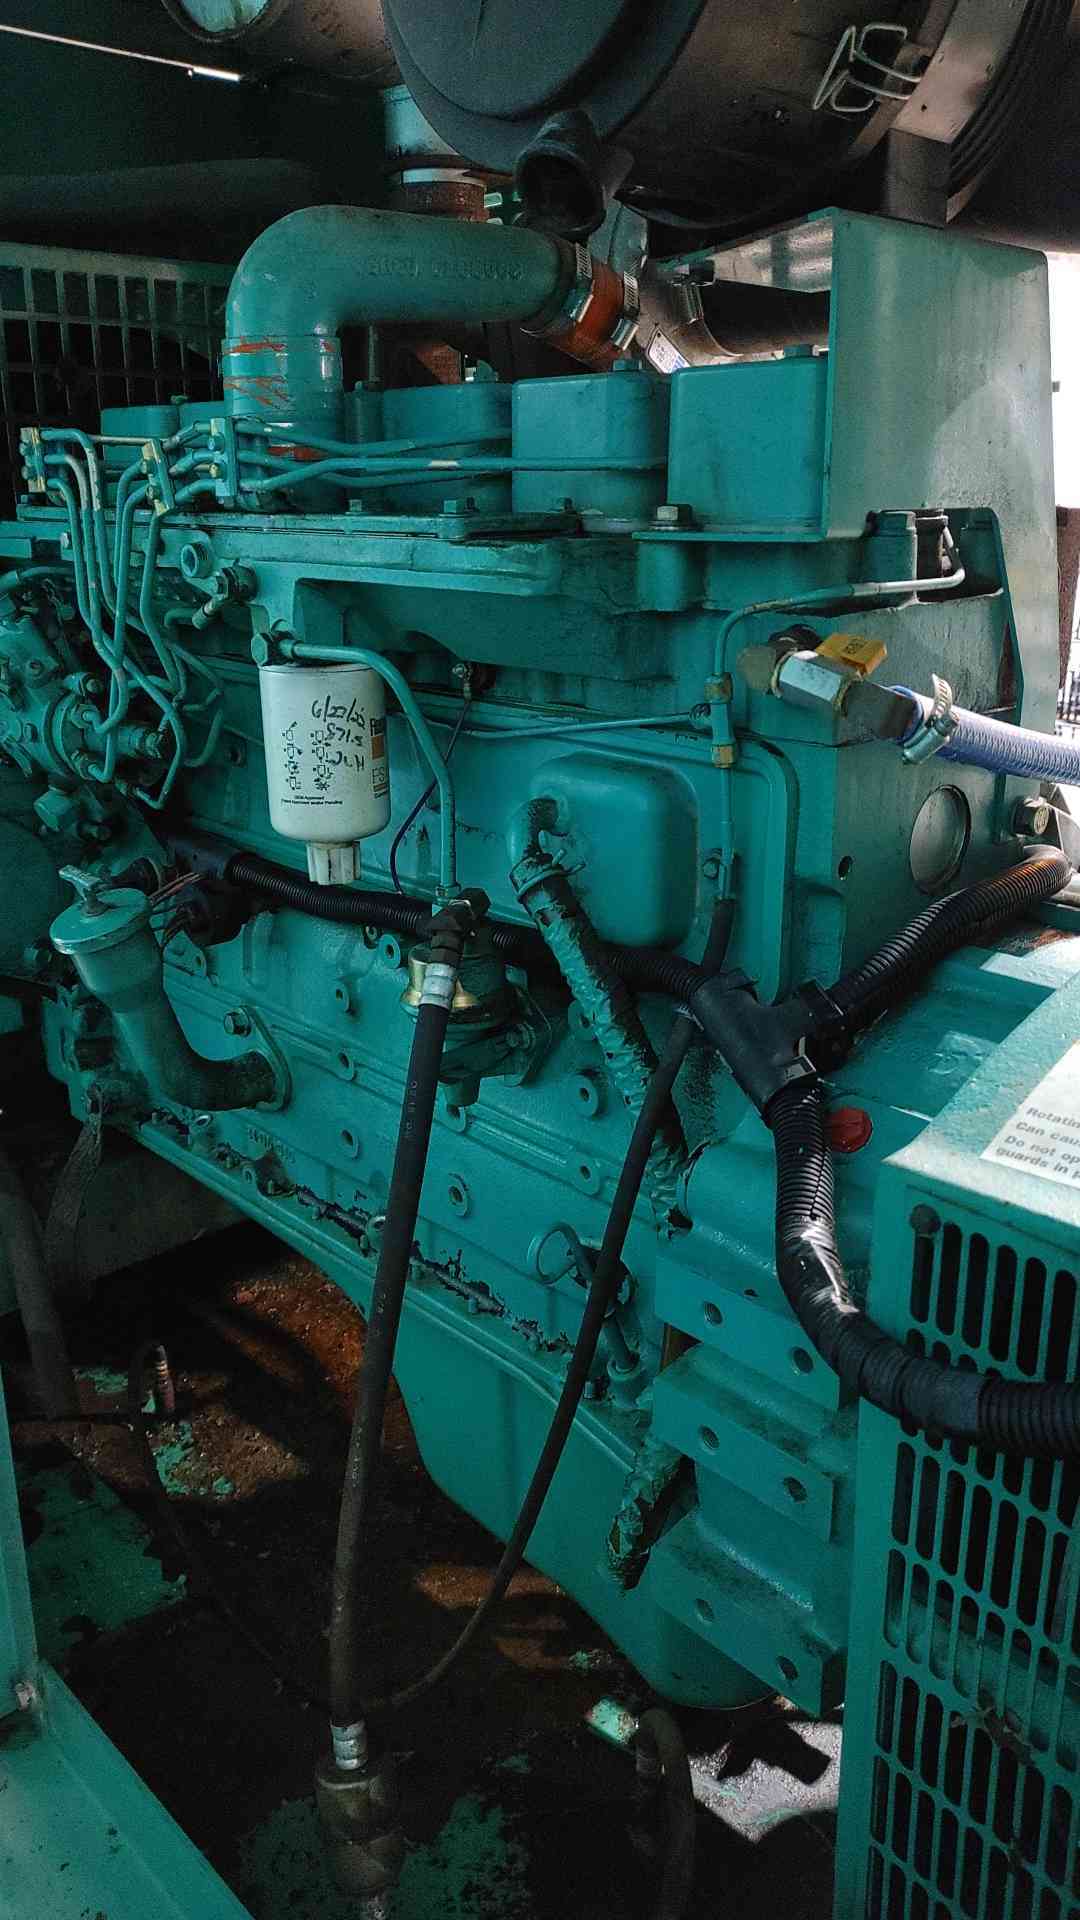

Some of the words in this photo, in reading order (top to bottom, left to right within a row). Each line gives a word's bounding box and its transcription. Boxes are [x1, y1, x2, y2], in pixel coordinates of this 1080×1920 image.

[1004, 1135, 1025, 1148] Do
[1030, 1143, 1056, 1156] not
[1016, 1121, 1045, 1135] Can
[1050, 1132, 1080, 1149] cau
[996, 1147, 1049, 1169] guards
[1053, 1162, 1069, 1174] in
